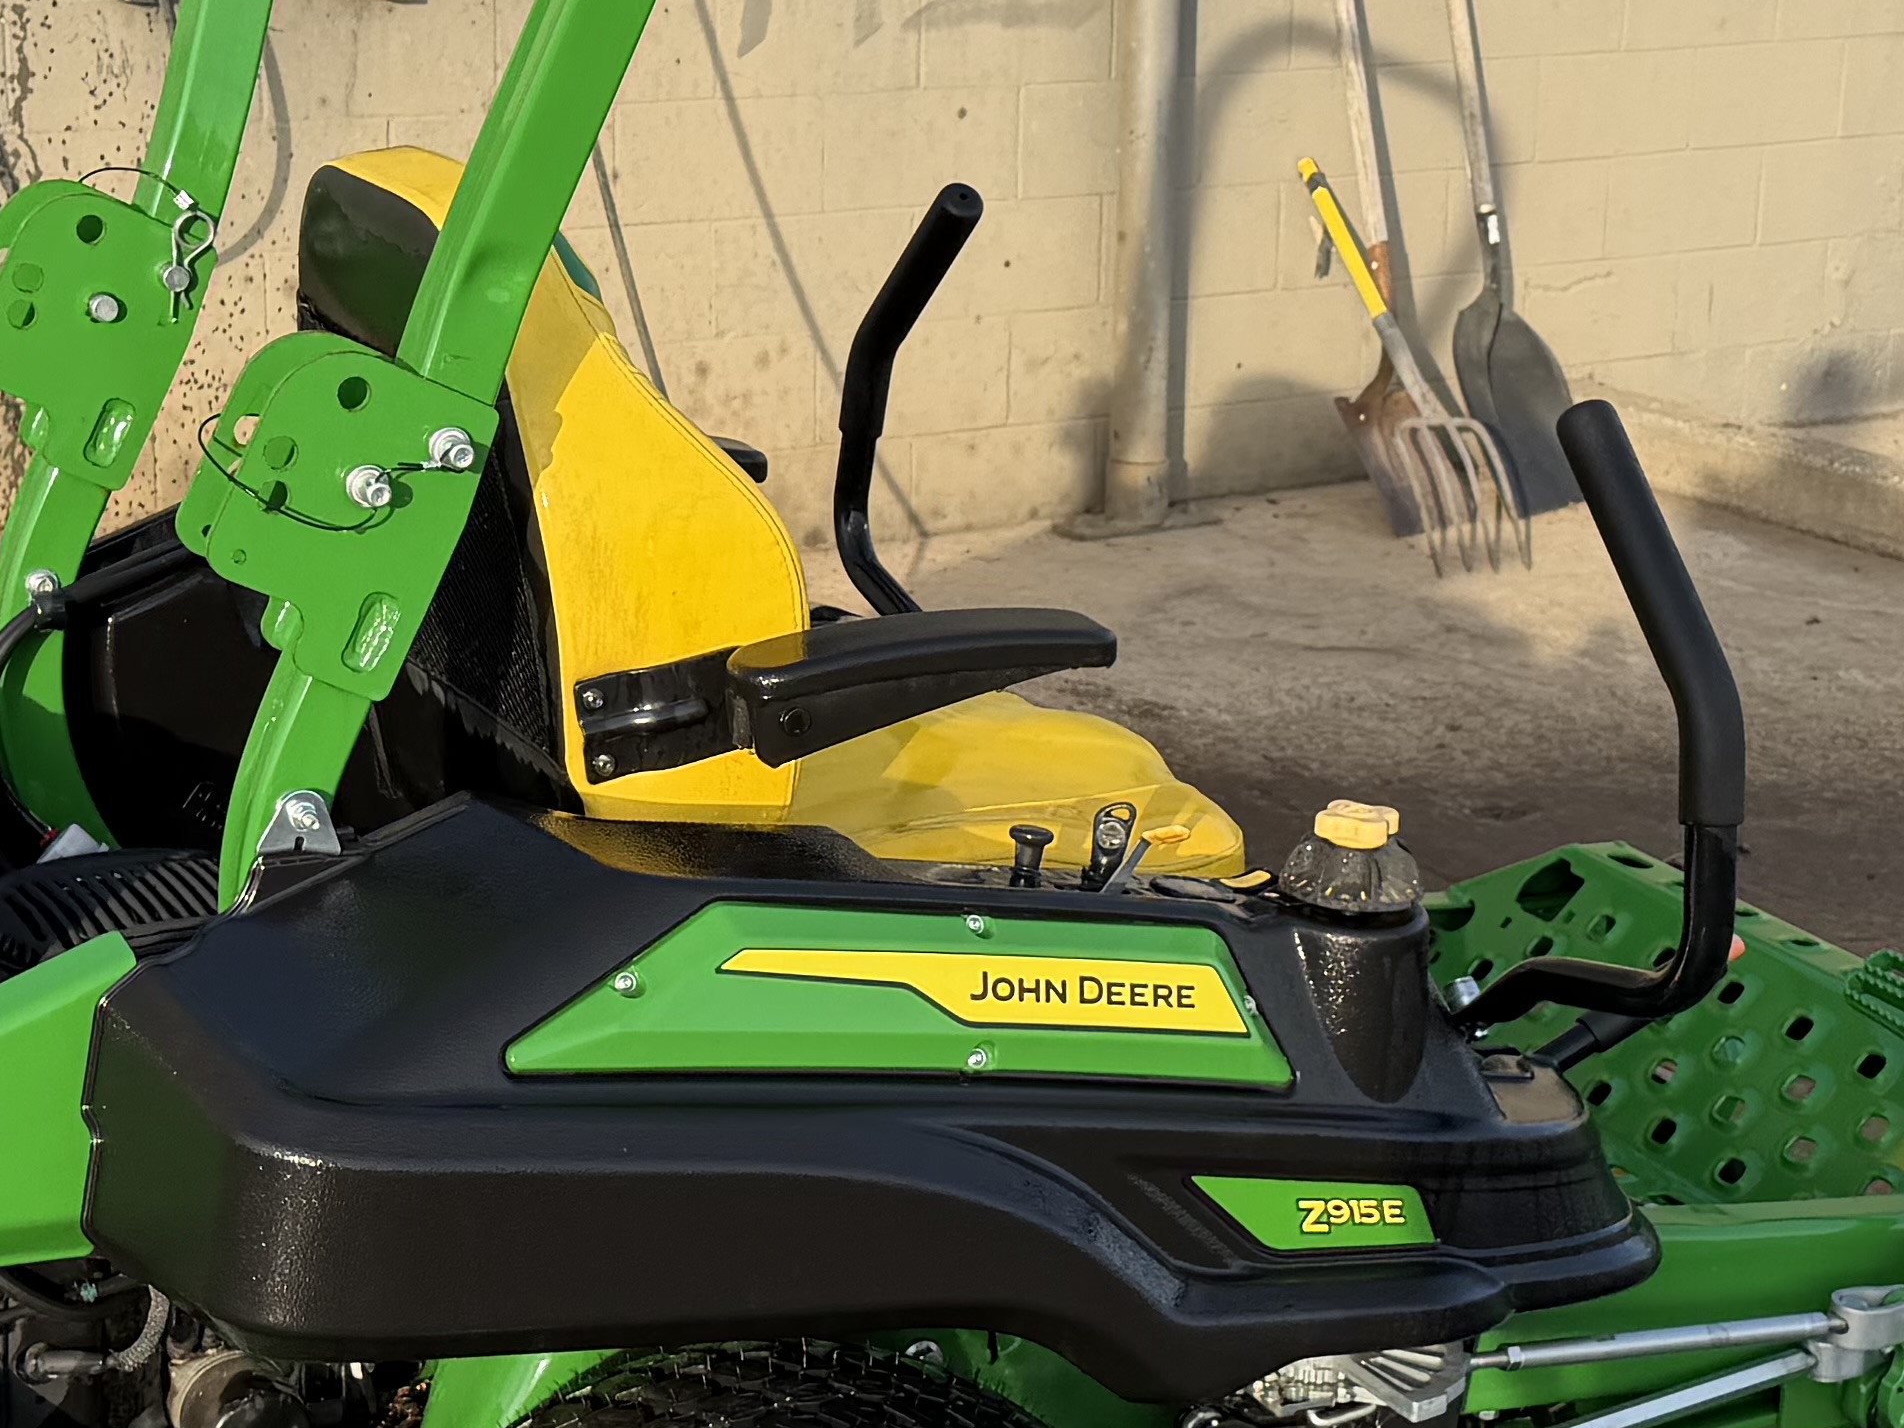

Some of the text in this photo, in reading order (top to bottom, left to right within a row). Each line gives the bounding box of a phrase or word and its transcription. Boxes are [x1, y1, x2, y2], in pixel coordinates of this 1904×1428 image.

[970, 971, 1195, 1008] JOHN DEERE
[1297, 1199, 1406, 1233] Z915E
